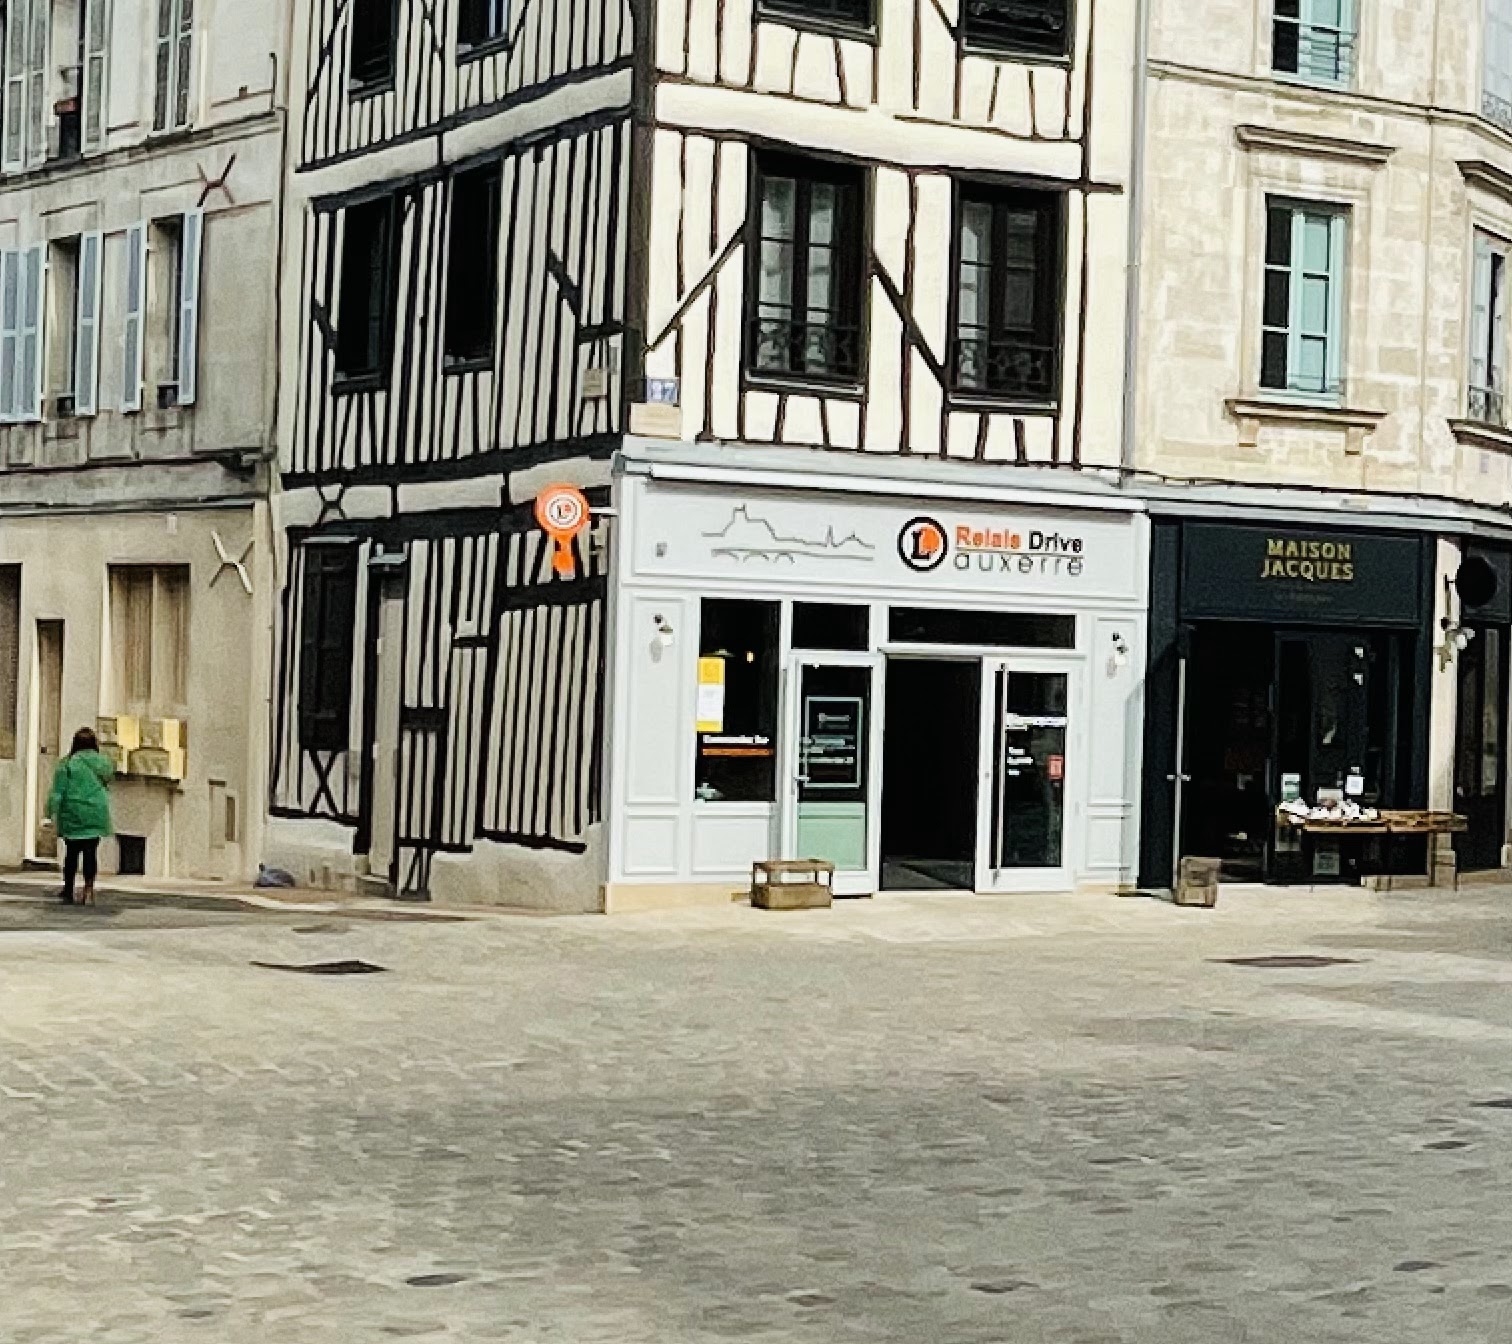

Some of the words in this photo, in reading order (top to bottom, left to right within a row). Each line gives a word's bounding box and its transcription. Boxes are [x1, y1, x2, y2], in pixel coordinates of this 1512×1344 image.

[955, 525, 1021, 550] Relais
[1028, 529, 1084, 554] Drive
[1266, 538, 1351, 560] MAISON
[953, 553, 1084, 577] auxerre
[1260, 558, 1354, 582] JACQUES
